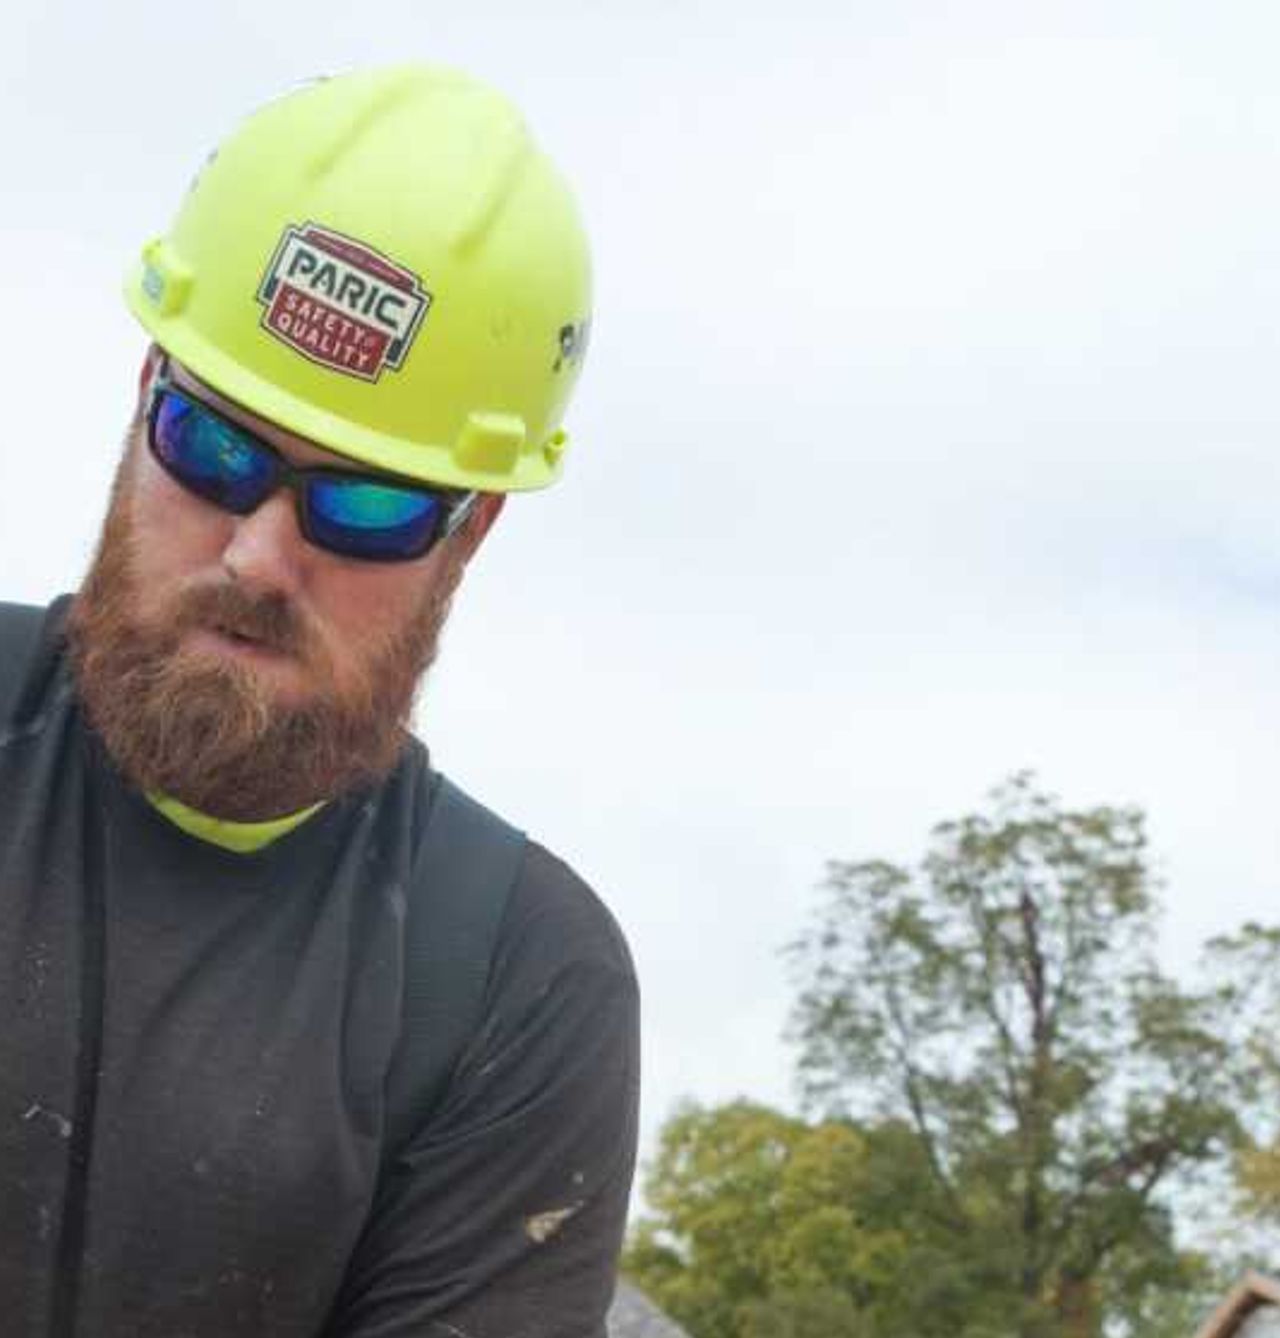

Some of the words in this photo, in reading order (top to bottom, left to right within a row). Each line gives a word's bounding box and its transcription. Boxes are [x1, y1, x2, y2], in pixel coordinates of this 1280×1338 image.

[287, 248, 407, 330] PARIC
[276, 312, 370, 368] QUALITY
[285, 291, 366, 344] SAFETY
